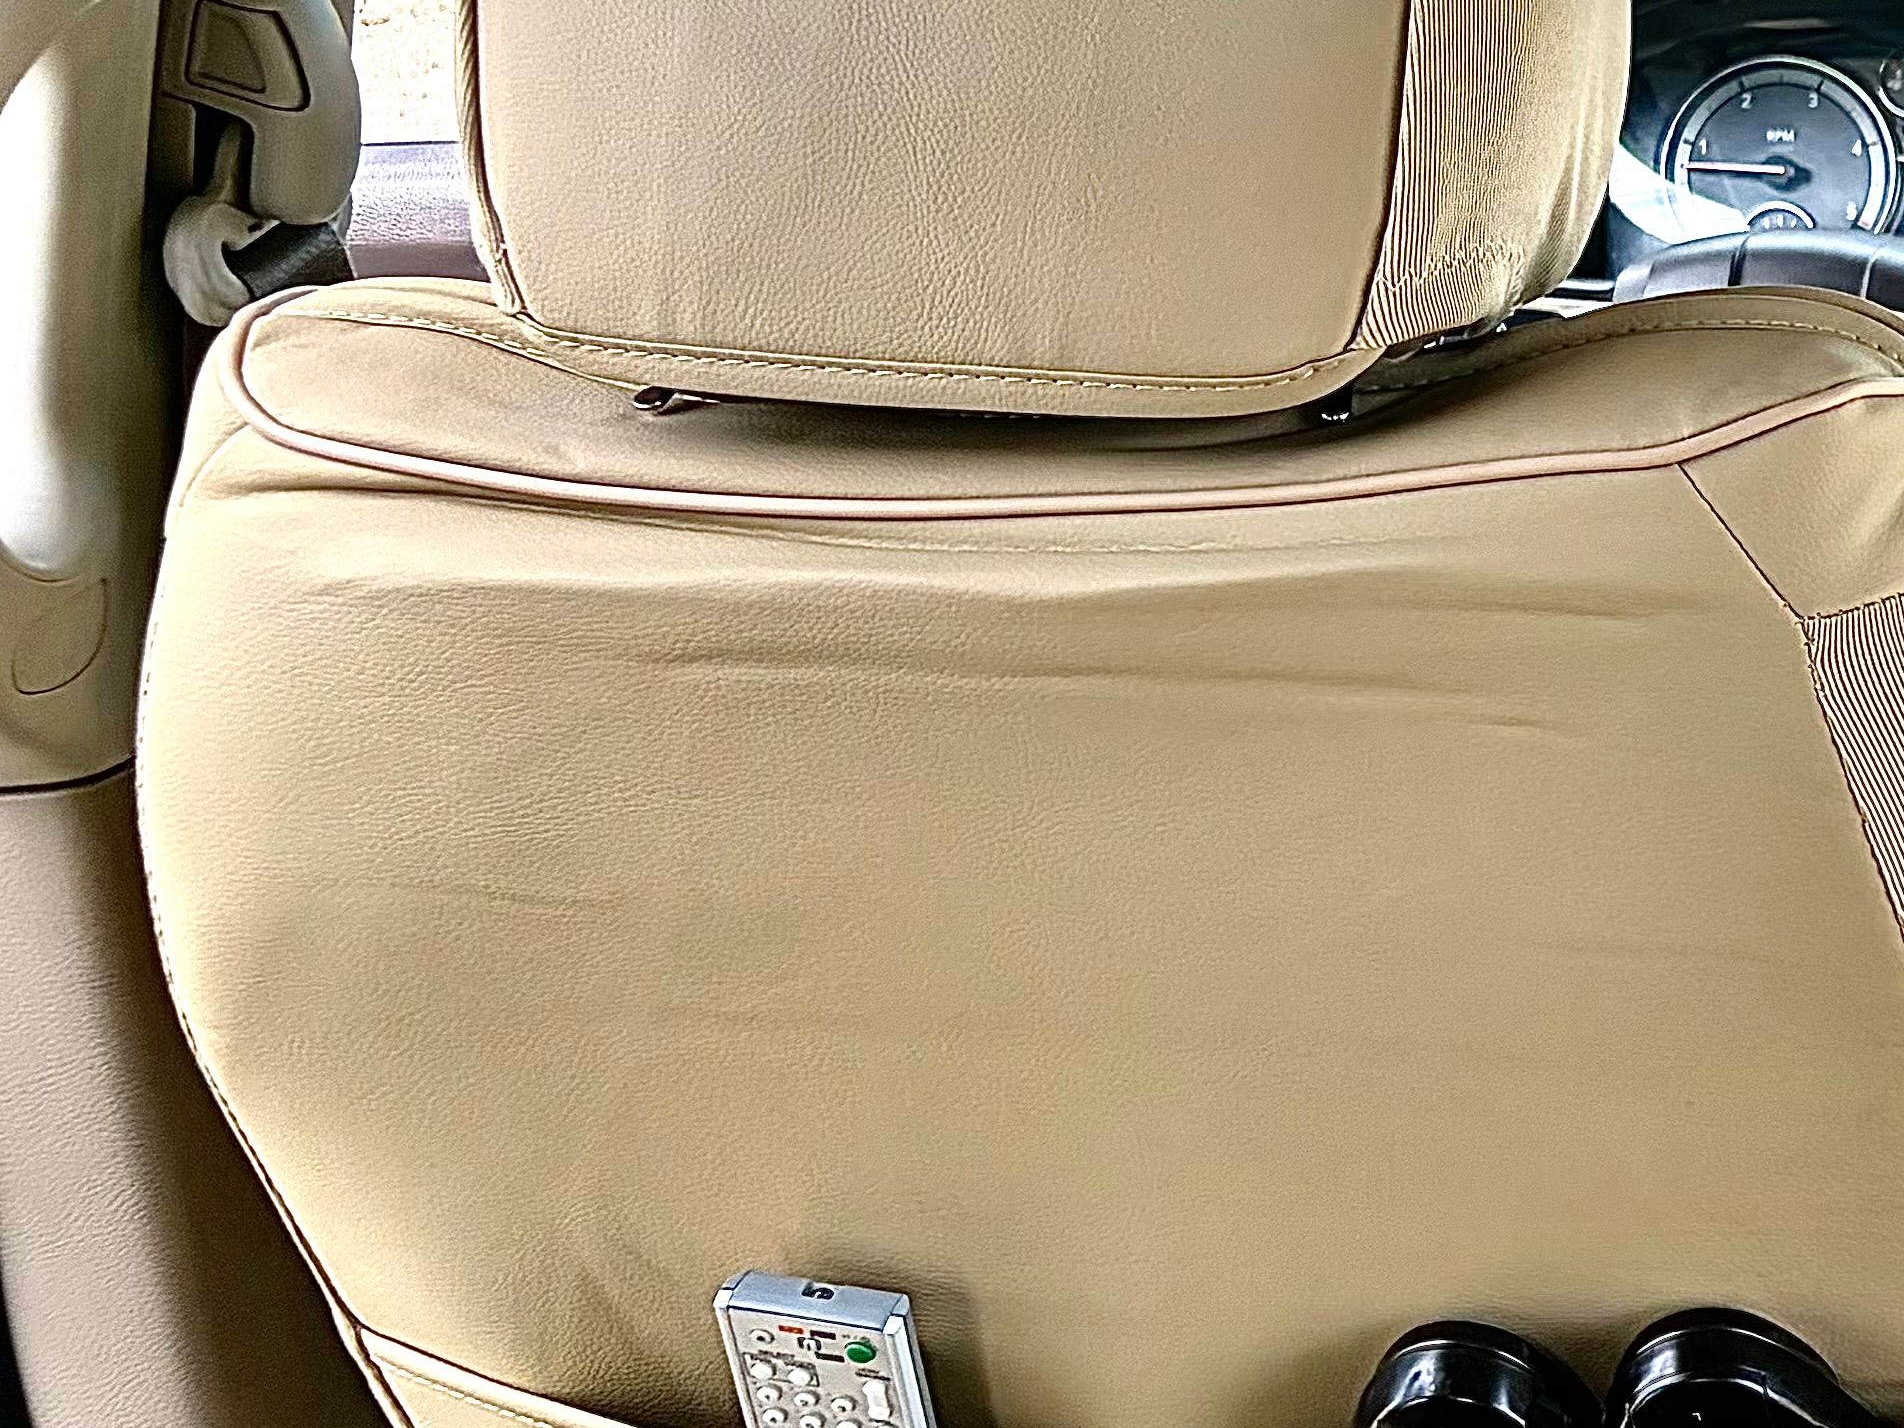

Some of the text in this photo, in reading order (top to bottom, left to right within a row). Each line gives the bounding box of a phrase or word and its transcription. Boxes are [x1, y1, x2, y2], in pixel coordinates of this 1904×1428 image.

[1741, 94, 1752, 109] 2
[1808, 92, 1819, 109] 3
[1699, 138, 1708, 156] 1
[1850, 139, 1863, 157] 4
